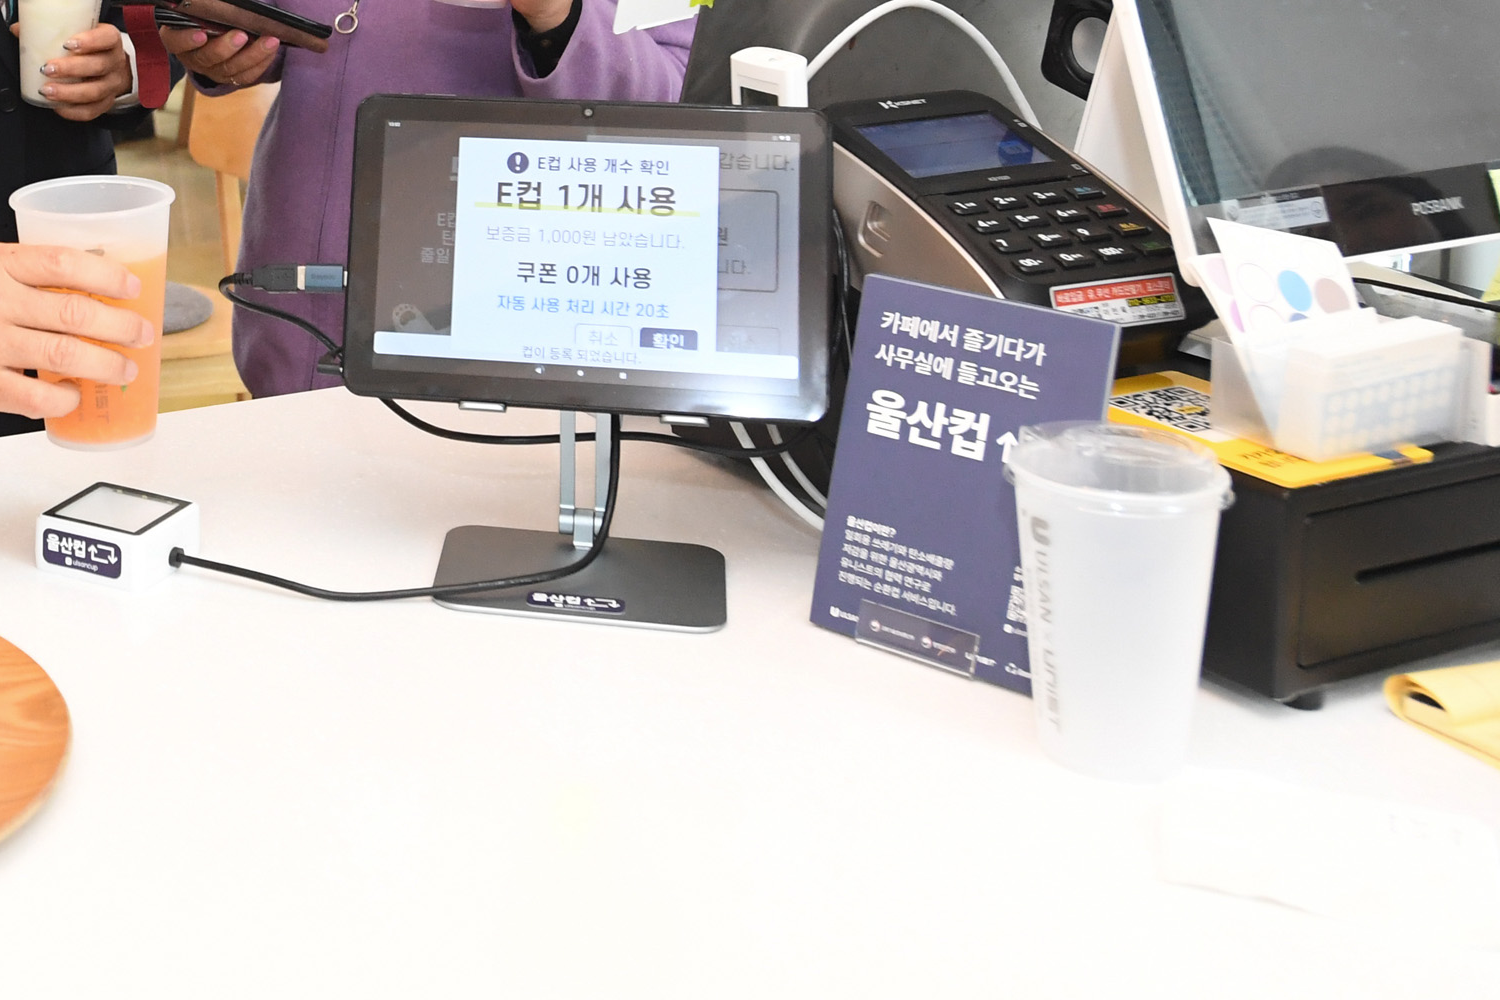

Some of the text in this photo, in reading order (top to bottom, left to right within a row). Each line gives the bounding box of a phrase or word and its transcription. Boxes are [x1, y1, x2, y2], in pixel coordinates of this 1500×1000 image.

[538, 156, 669, 175] E컵 사용 개수 확인
[497, 181, 676, 217] E컵 1개 사용
[1411, 196, 1465, 217] POSBANK
[486, 226, 685, 249] 보증금 1,000원 남았습니다.
[517, 261, 652, 289] 쿠폰 0개 사용
[497, 295, 669, 319] 자동 사용 처리 시간 20초
[652, 332, 684, 349] 확인
[880, 311, 1047, 367] 카페에서 즐기다가
[874, 343, 1041, 400] 사무실에 들고오는
[866, 389, 991, 462] 울산컵
[46, 533, 86, 559] 울산컵
